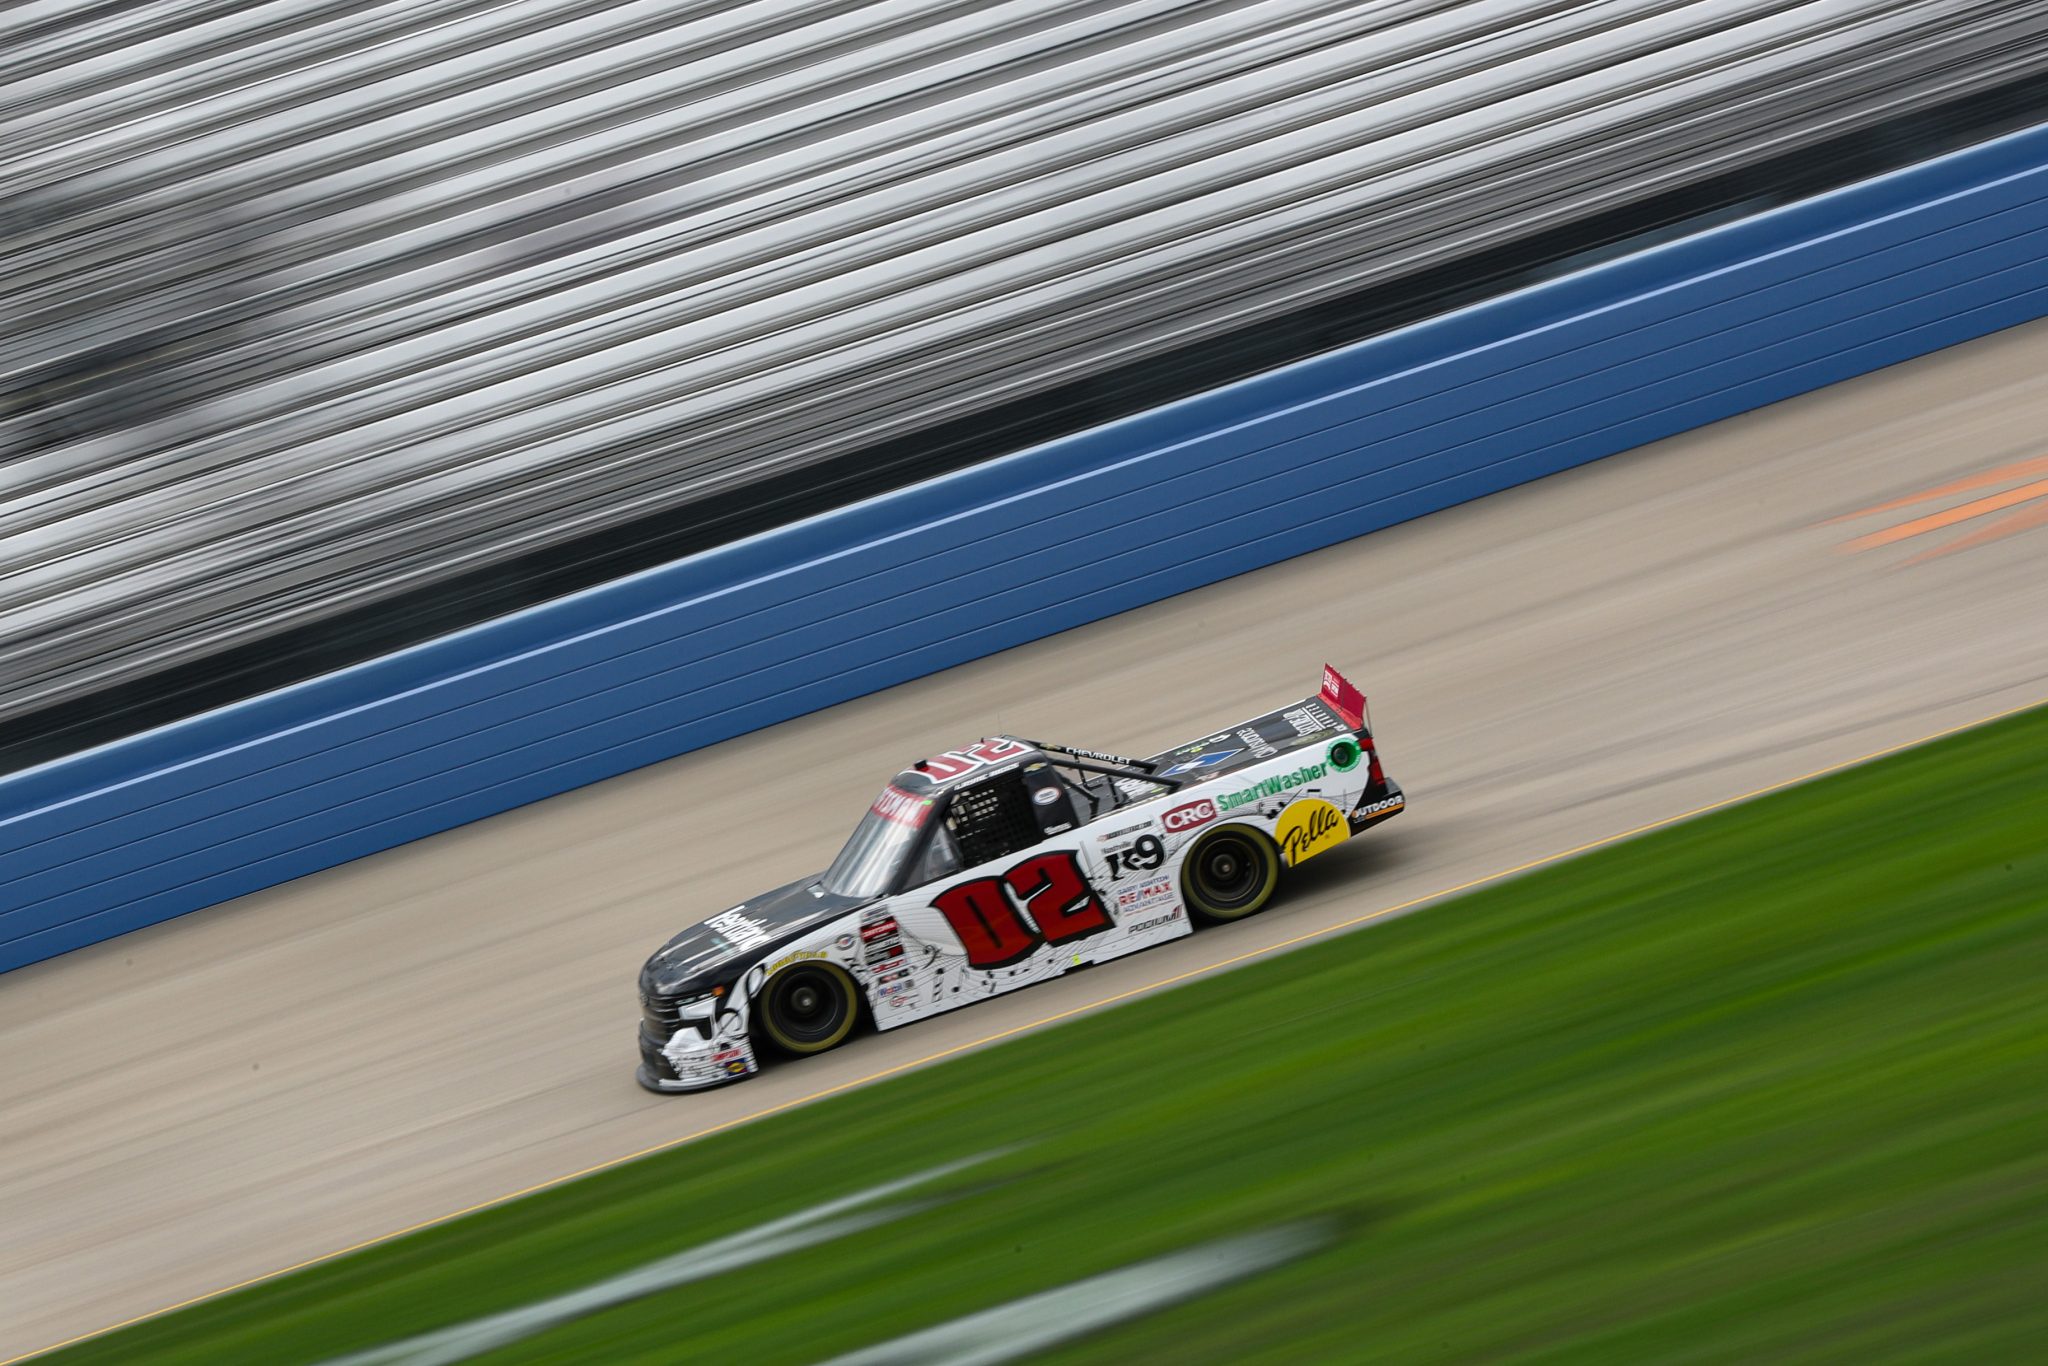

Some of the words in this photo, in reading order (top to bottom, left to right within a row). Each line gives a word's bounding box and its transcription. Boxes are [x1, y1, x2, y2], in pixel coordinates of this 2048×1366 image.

[1065, 747, 1132, 765] CHEVROLET
[1216, 761, 1328, 812] SmartWasher
[1164, 802, 1215, 829] CRC
[1352, 795, 1403, 818] OUTDOOR
[1280, 805, 1340, 865] Pella
[928, 849, 1117, 970] 02
